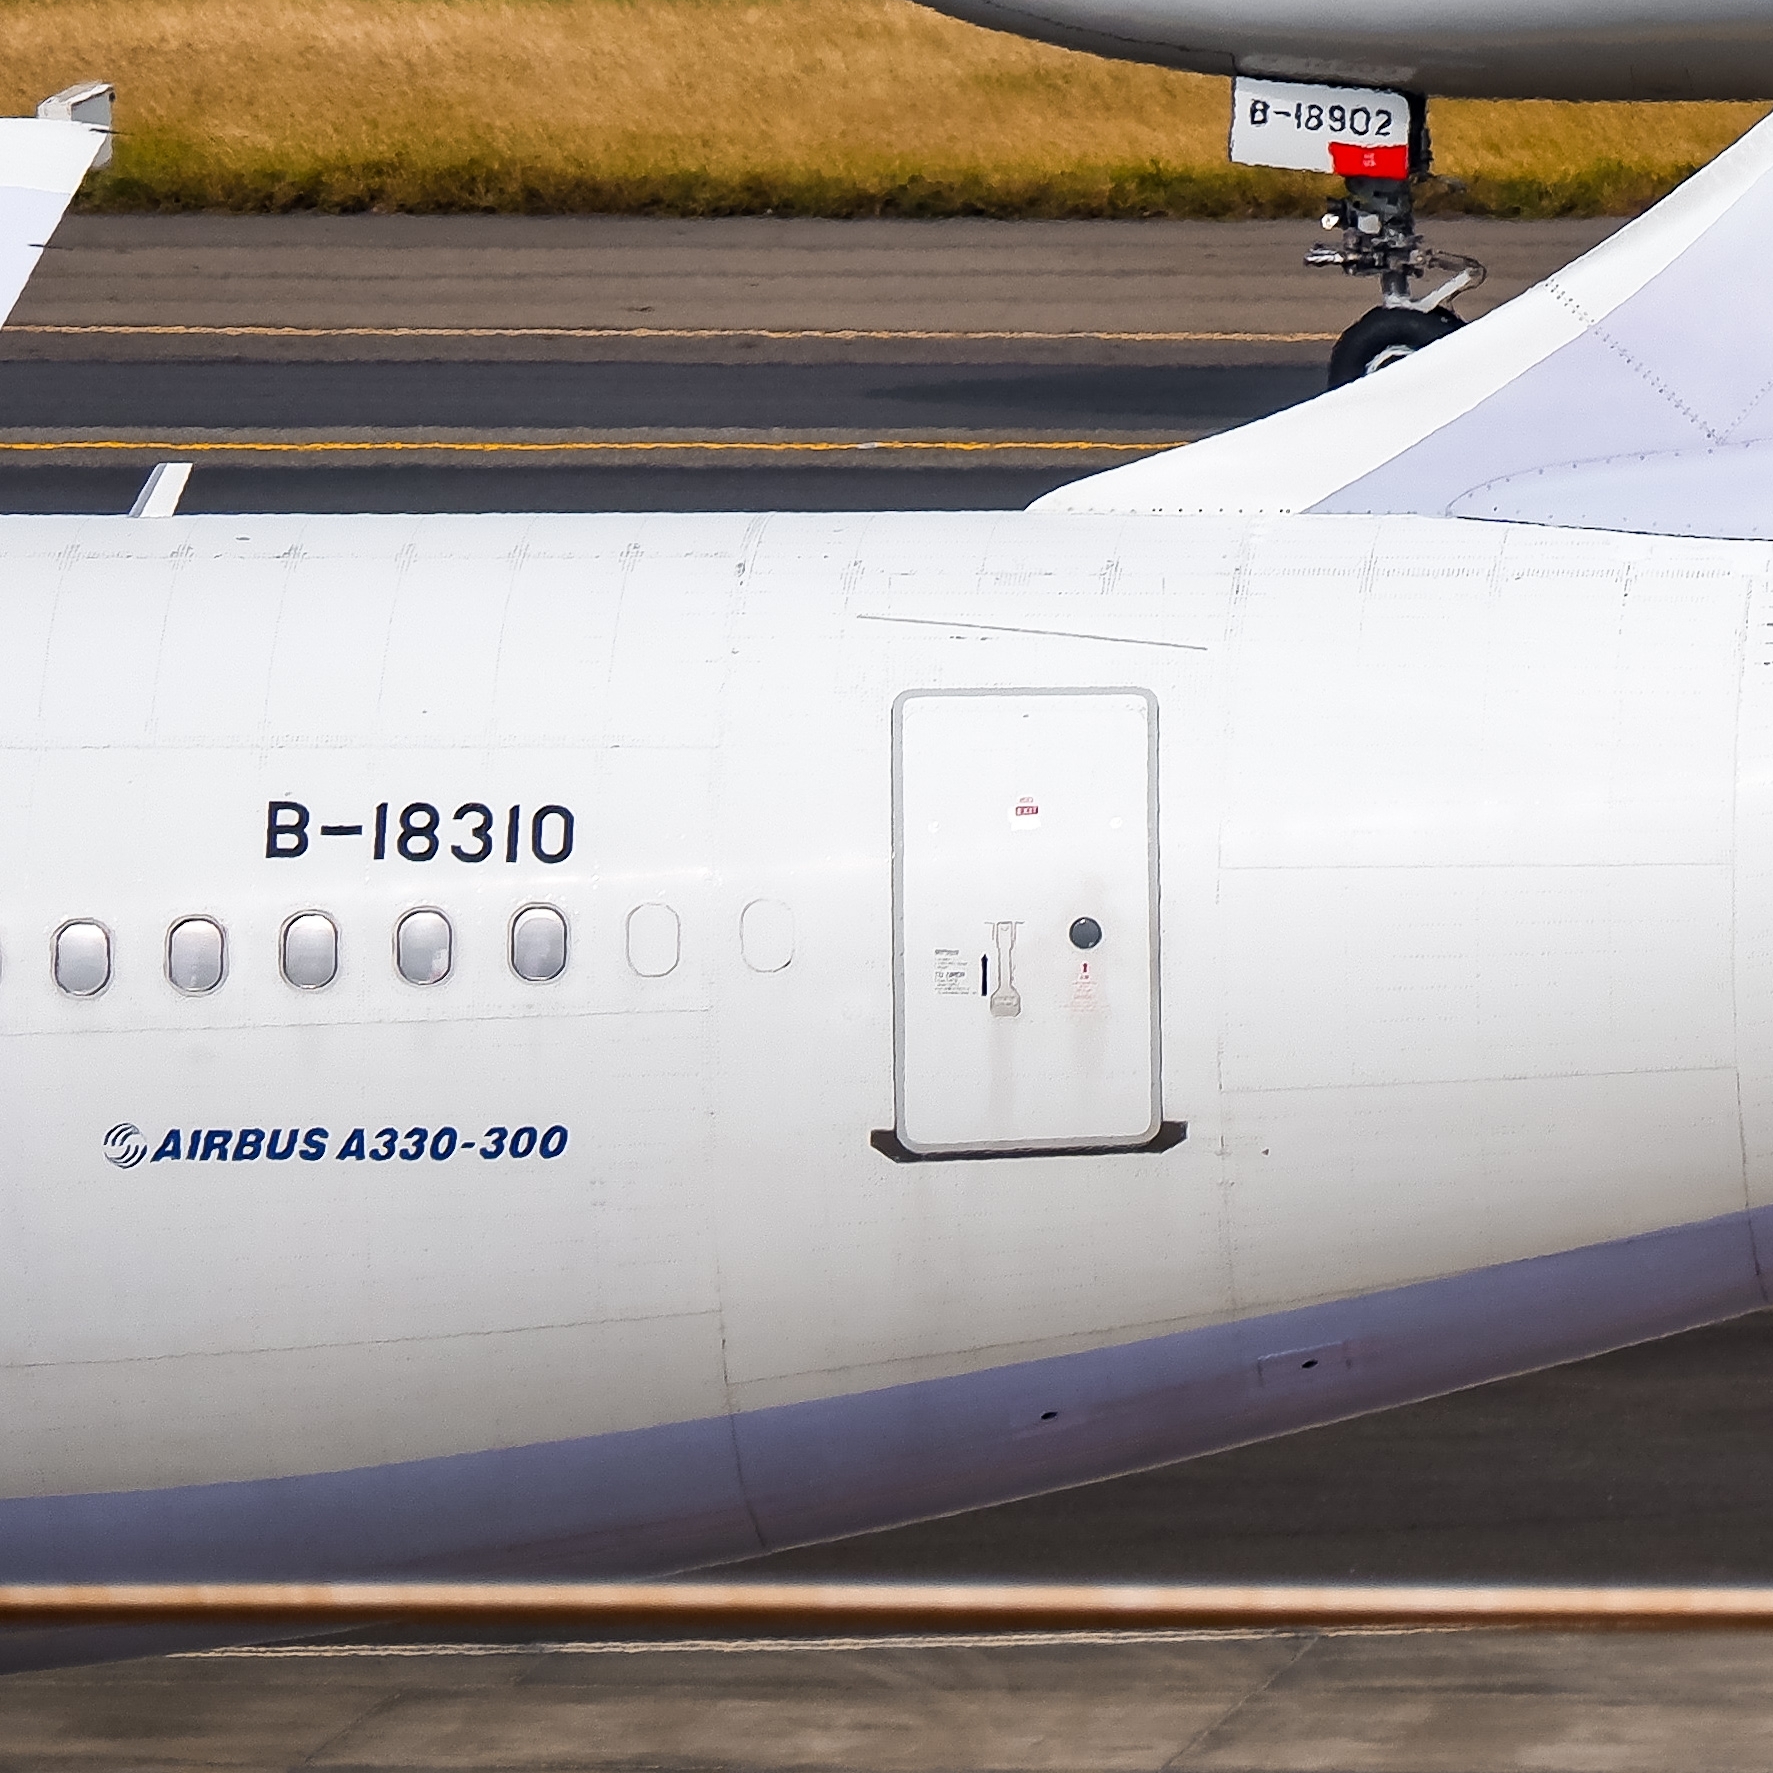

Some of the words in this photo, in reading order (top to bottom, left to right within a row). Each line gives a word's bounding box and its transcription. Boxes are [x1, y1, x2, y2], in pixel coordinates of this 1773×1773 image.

[1249, 98, 1393, 137] B-18902
[265, 800, 576, 865] B-18310
[151, 1126, 330, 1163] AIRBUS
[336, 1124, 568, 1162] A330-300
